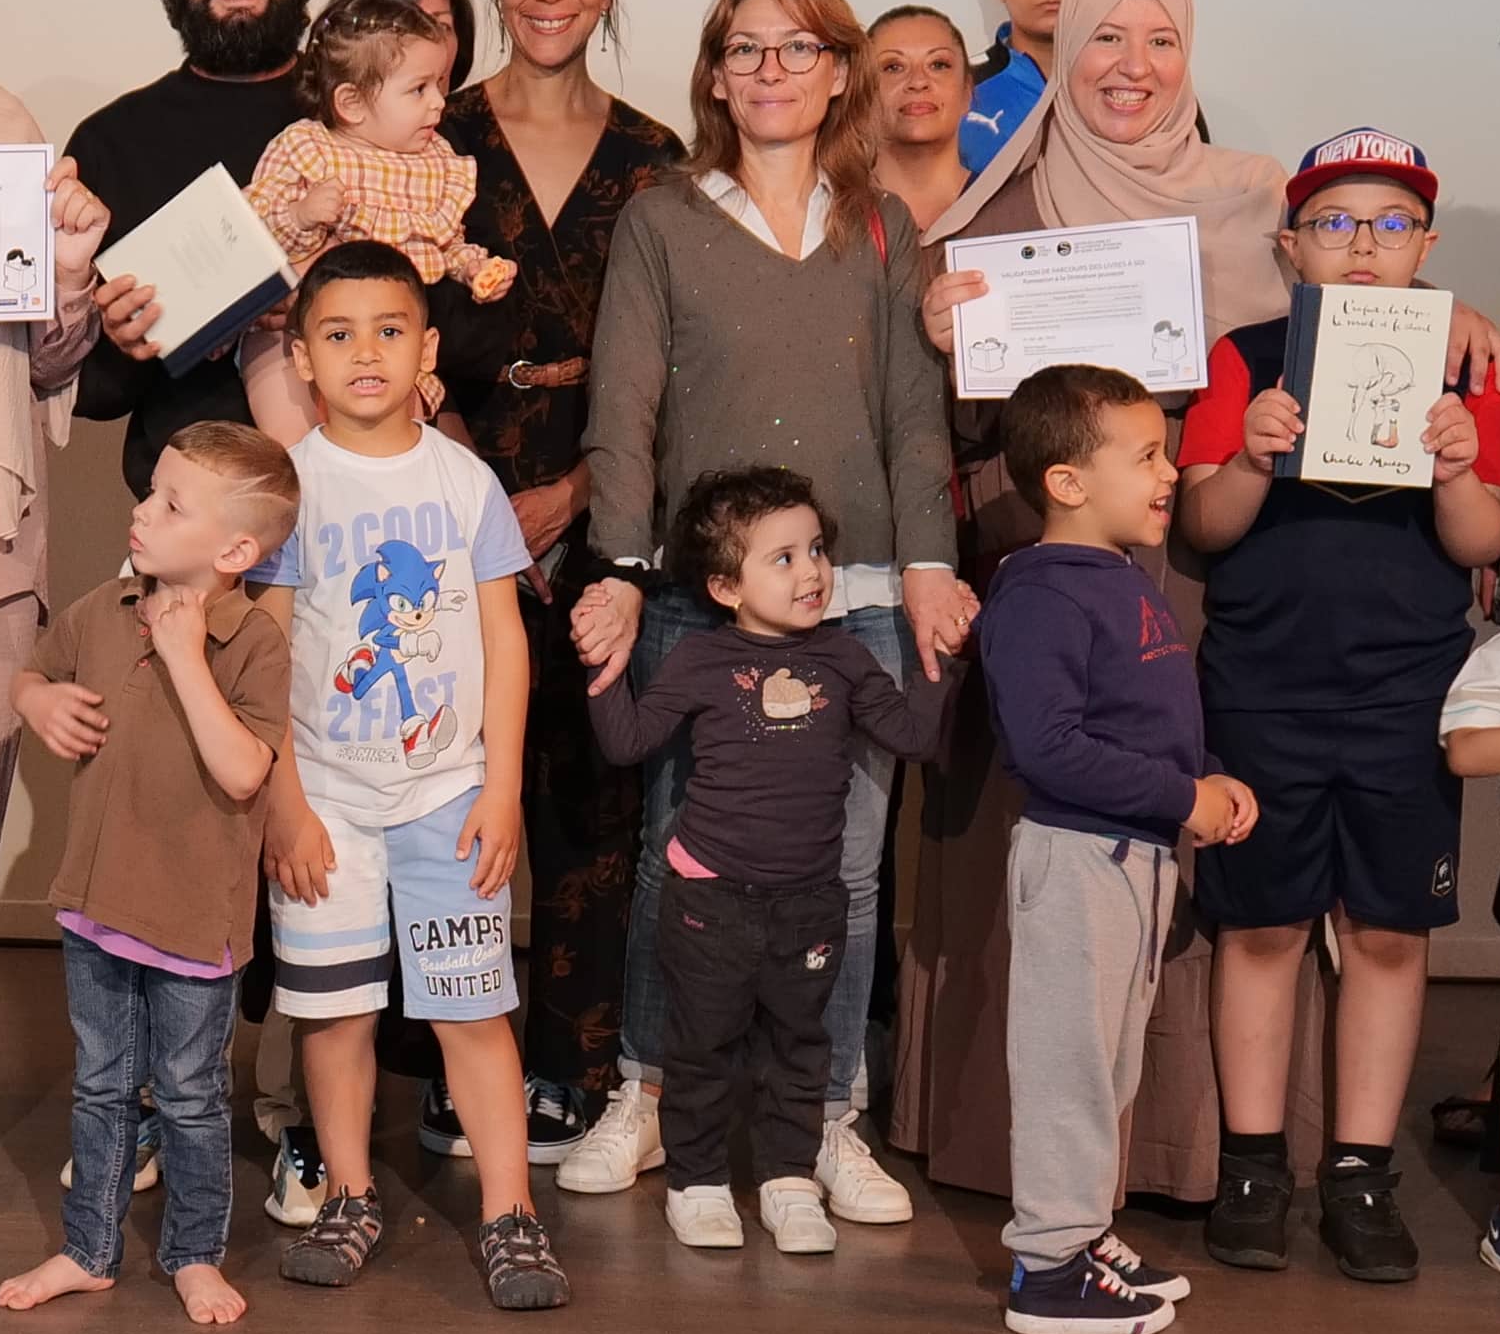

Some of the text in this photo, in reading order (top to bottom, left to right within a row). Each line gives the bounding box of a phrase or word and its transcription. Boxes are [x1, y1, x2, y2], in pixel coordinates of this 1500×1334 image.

[318, 523, 346, 579] 2
[326, 693, 353, 742] 2
[409, 914, 504, 953] CAMPS
[419, 952, 470, 972] Baseball
[425, 968, 502, 997] UNITED
